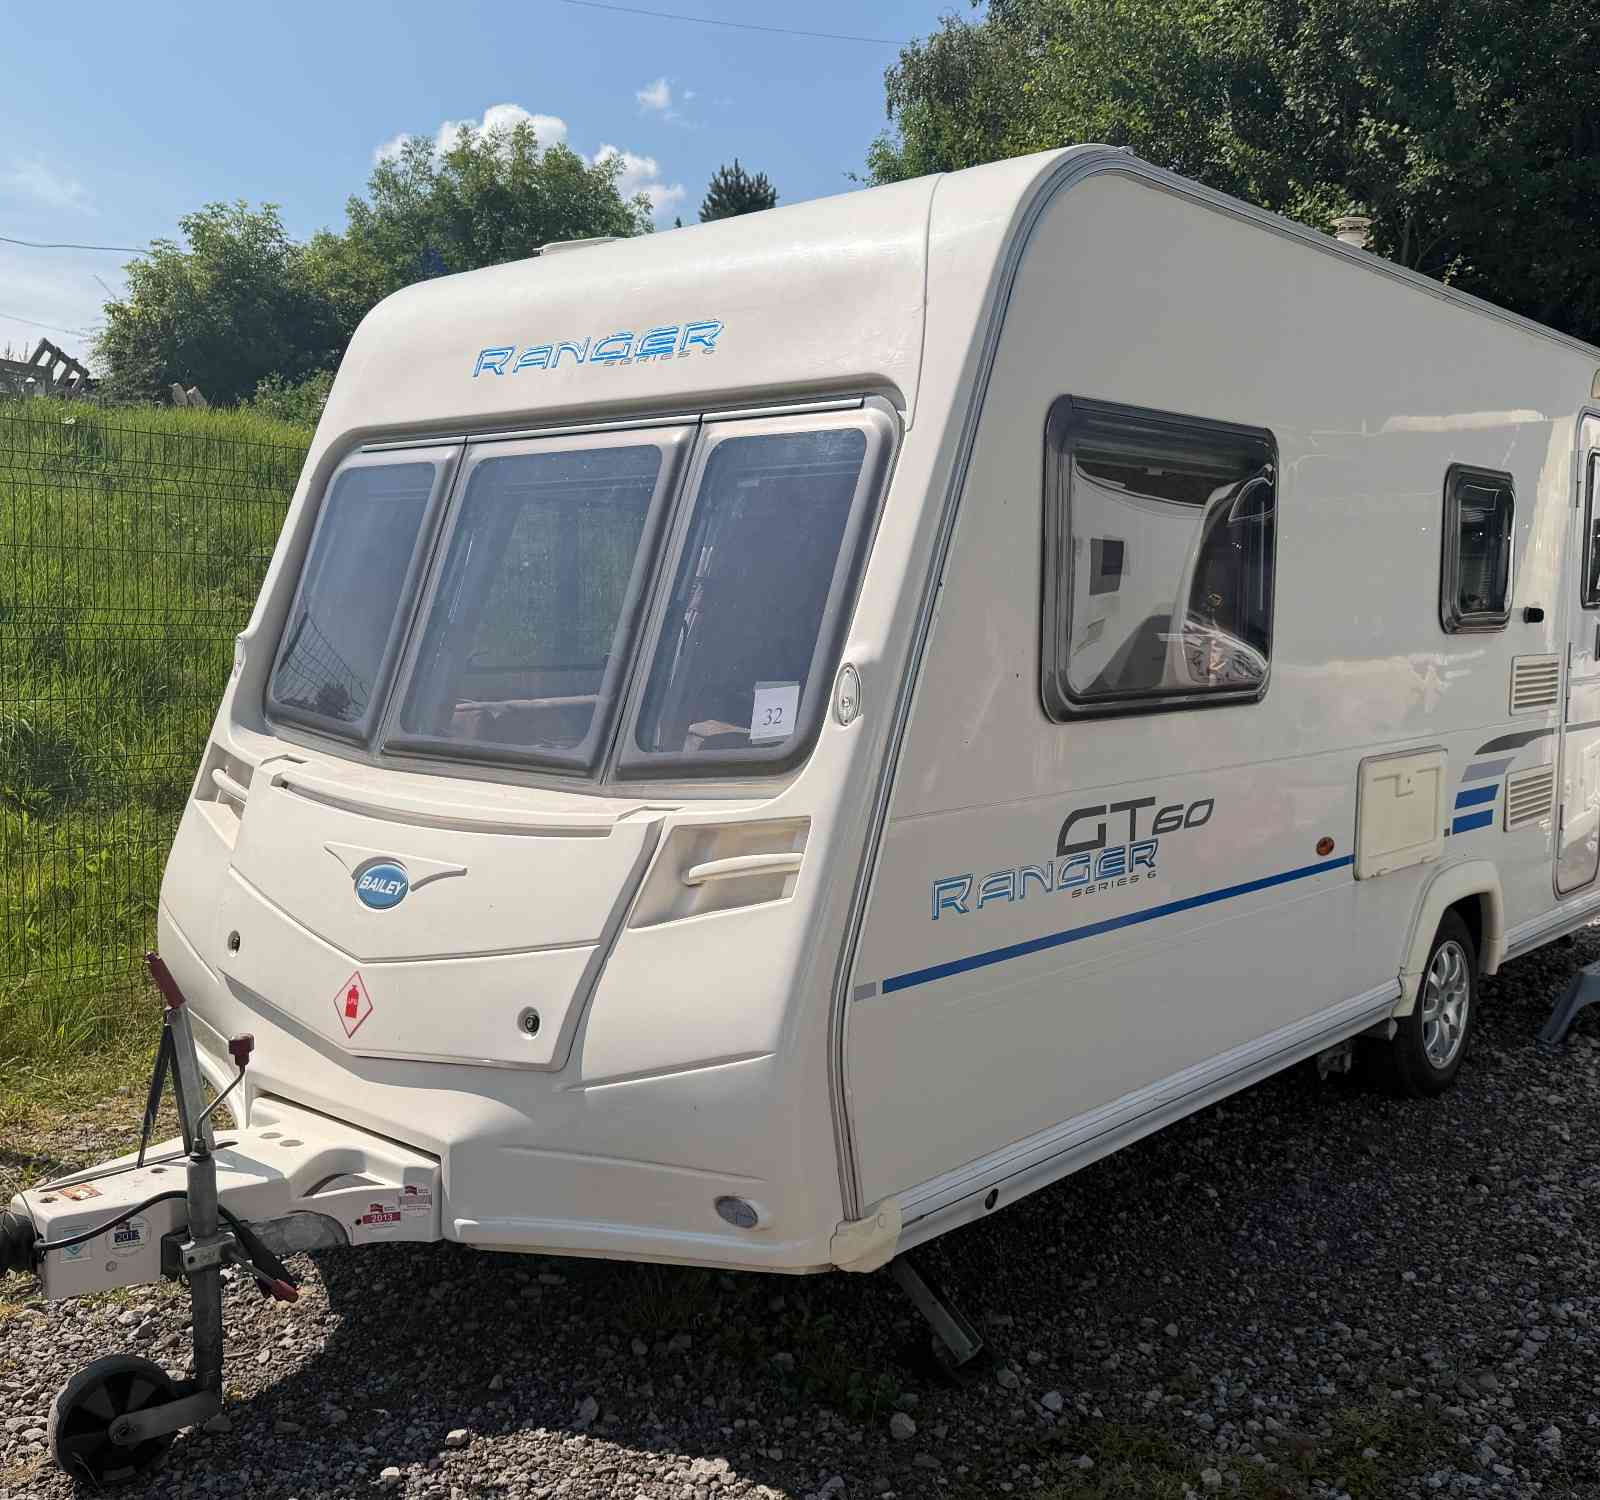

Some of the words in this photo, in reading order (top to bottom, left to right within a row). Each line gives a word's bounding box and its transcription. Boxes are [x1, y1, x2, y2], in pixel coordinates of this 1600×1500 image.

[472, 320, 724, 378] RANGER
[762, 706, 783, 726] 32
[358, 876, 406, 896] BAILEY
[932, 837, 1159, 921] RANGER
[1071, 875, 1140, 899] SERIES
[1147, 870, 1157, 879] 6
[370, 1214, 393, 1224] 2013
